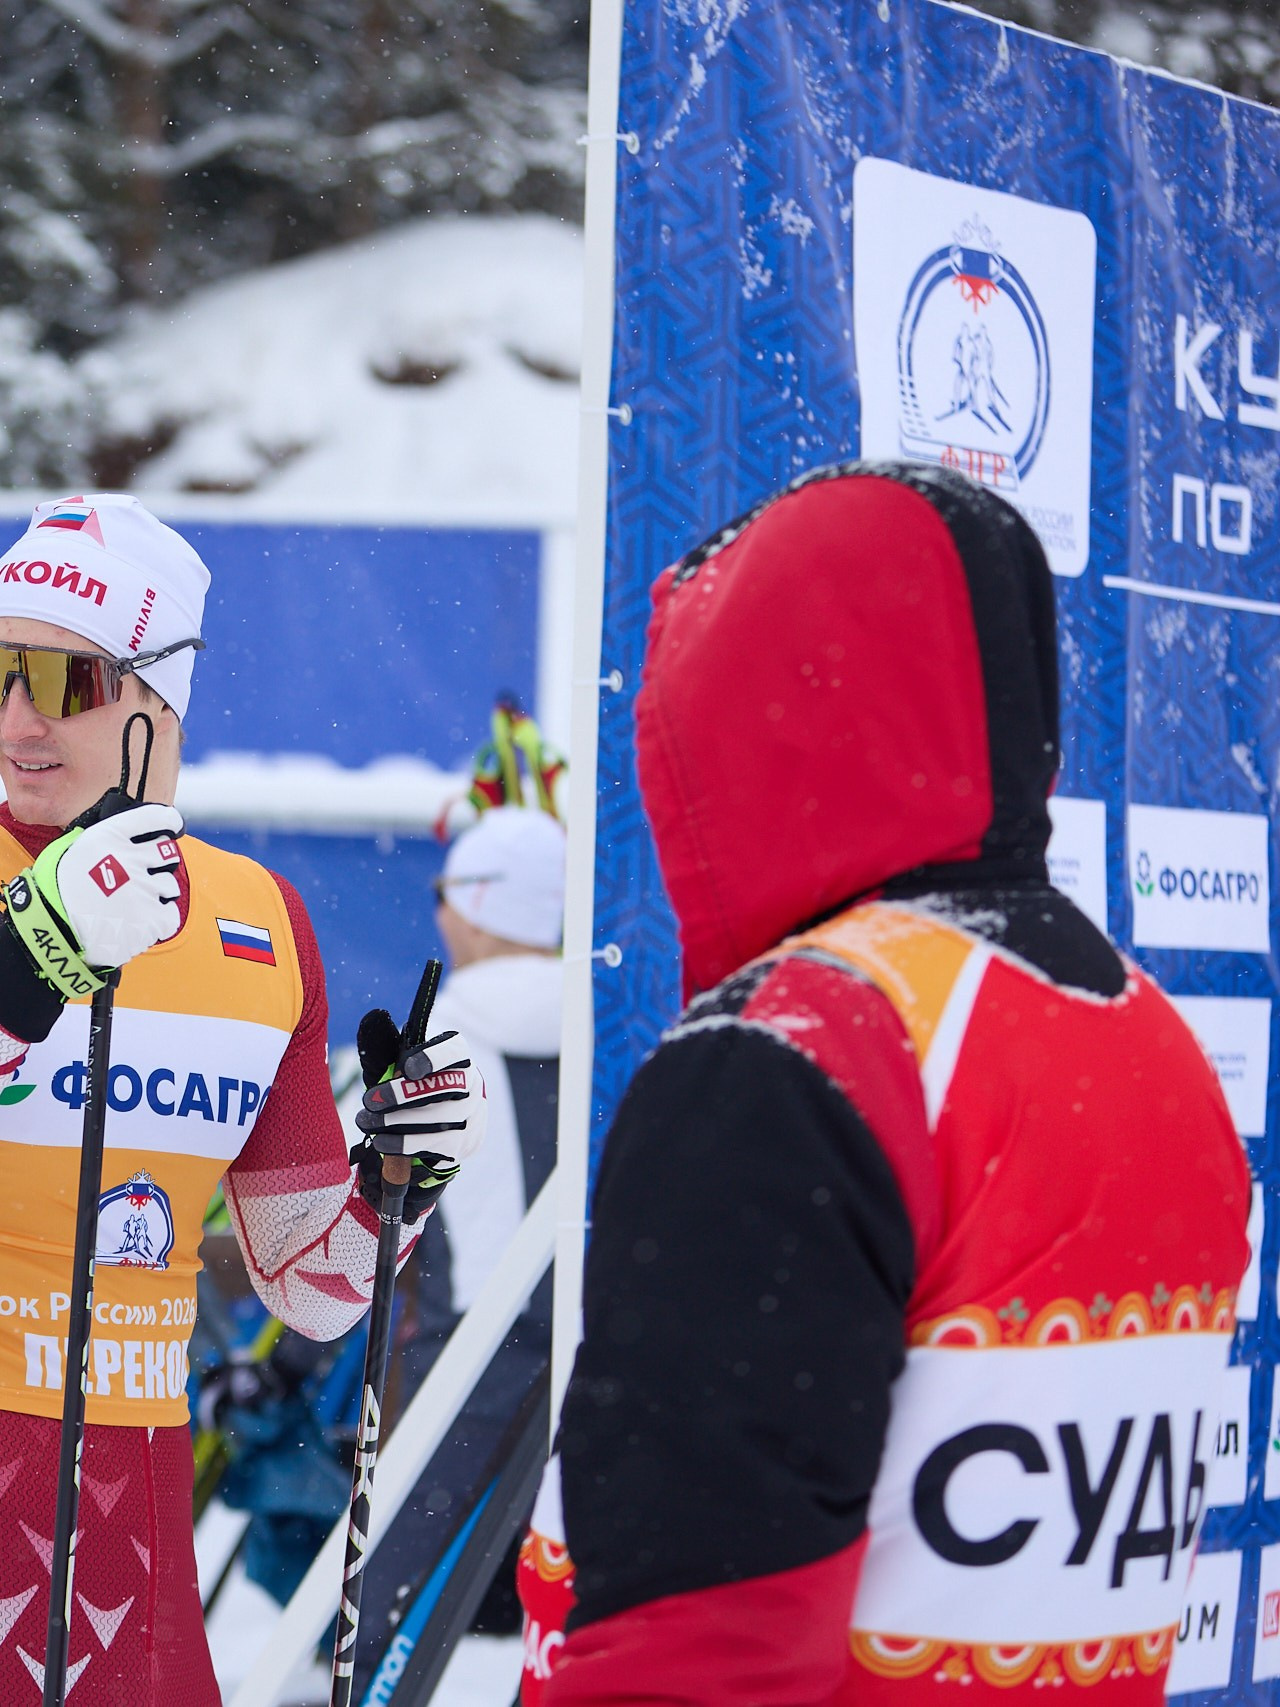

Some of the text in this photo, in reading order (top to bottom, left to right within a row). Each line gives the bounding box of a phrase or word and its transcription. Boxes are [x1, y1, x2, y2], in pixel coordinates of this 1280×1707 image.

[128, 588, 156, 652] BIVIUM
[1159, 866, 1260, 903] ФОСАГРО
[405, 1073, 464, 1094] BIVIUM
[49, 1291, 157, 1326] Рссии
[160, 1297, 196, 1326] 2026
[24, 1332, 190, 1399] ПРЕКО
